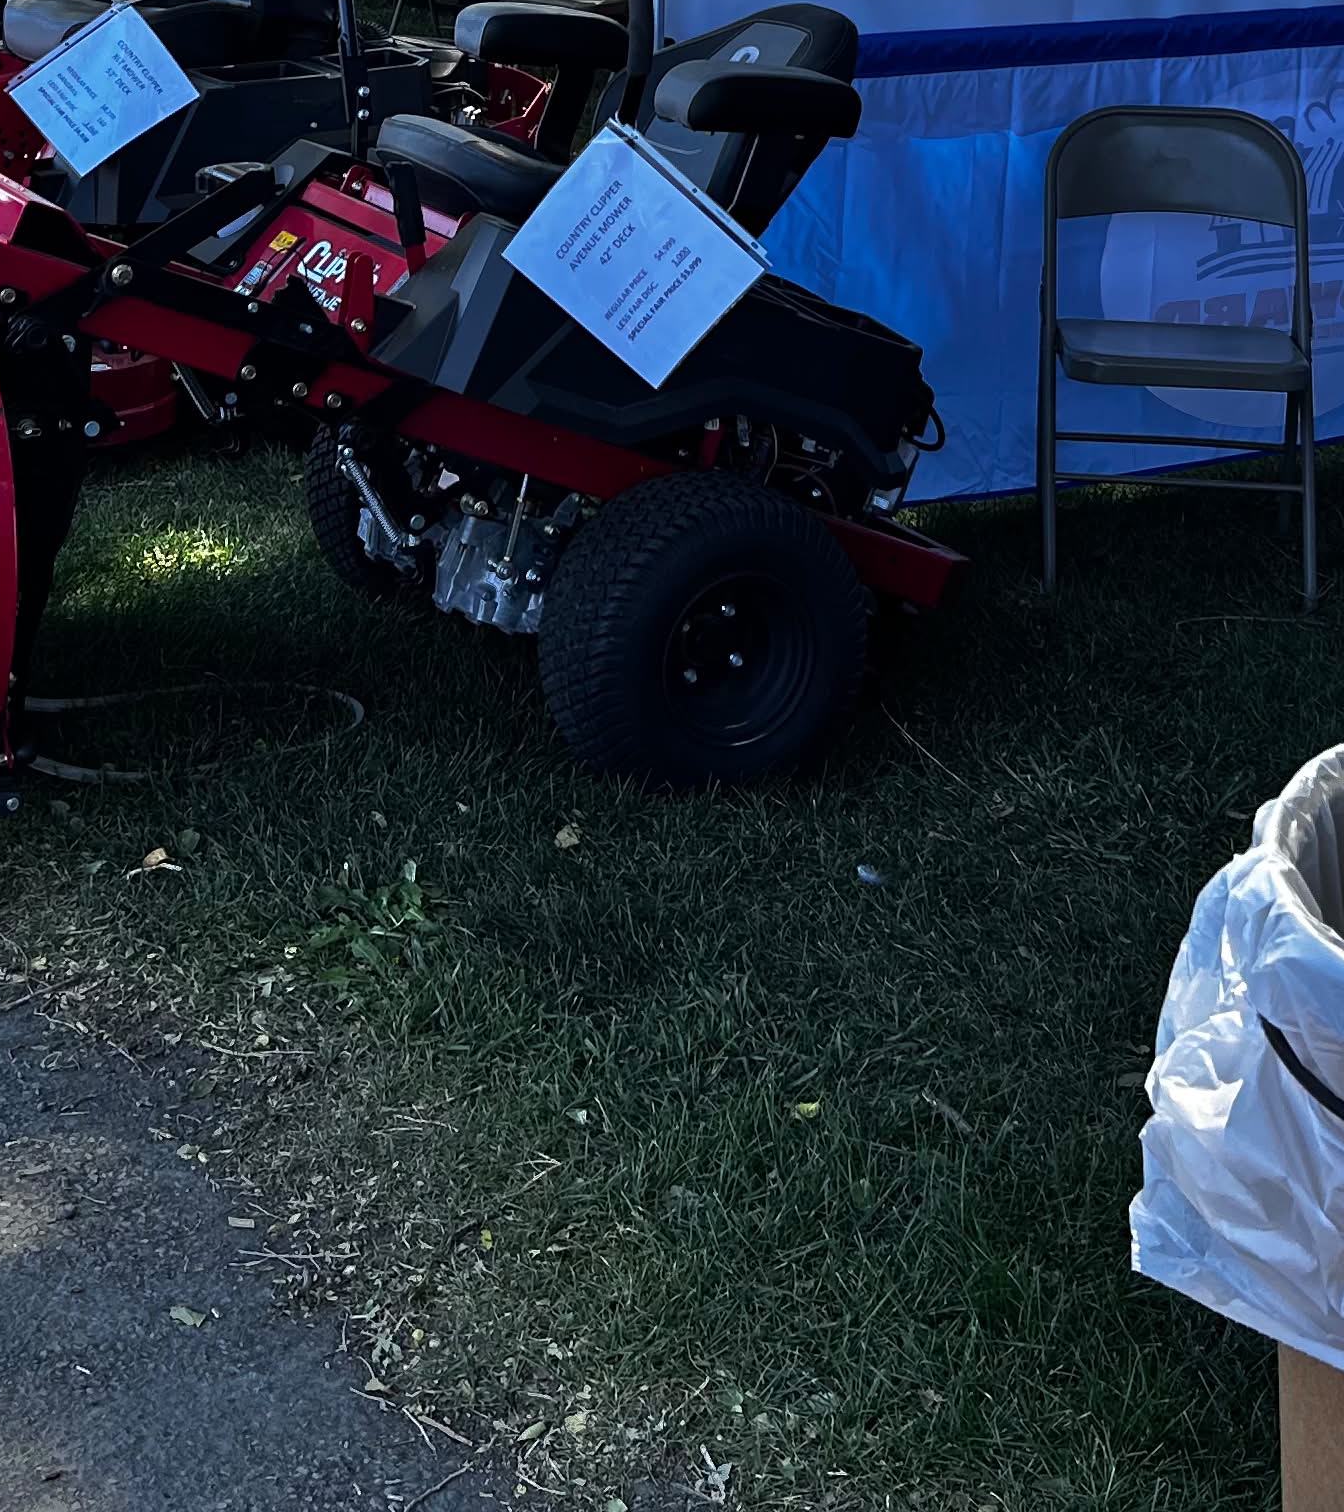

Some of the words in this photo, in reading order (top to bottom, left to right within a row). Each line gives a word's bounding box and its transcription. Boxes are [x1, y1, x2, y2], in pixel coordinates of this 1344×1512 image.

[115, 78, 132, 96] DECK
[554, 214, 594, 261] COUNTRY
[589, 179, 624, 218] CLIPPER
[566, 231, 602, 272] AVENUE
[598, 195, 634, 235] MOWER
[611, 222, 637, 250] DECK
[601, 286, 633, 320] REGULAR
[627, 267, 649, 290] PRICE
[613, 311, 632, 331] LESS
[626, 296, 646, 316] FAIR
[626, 310, 655, 342] SPECIAL
[649, 296, 668, 315] FAIR
[662, 277, 685, 301] PRICE
